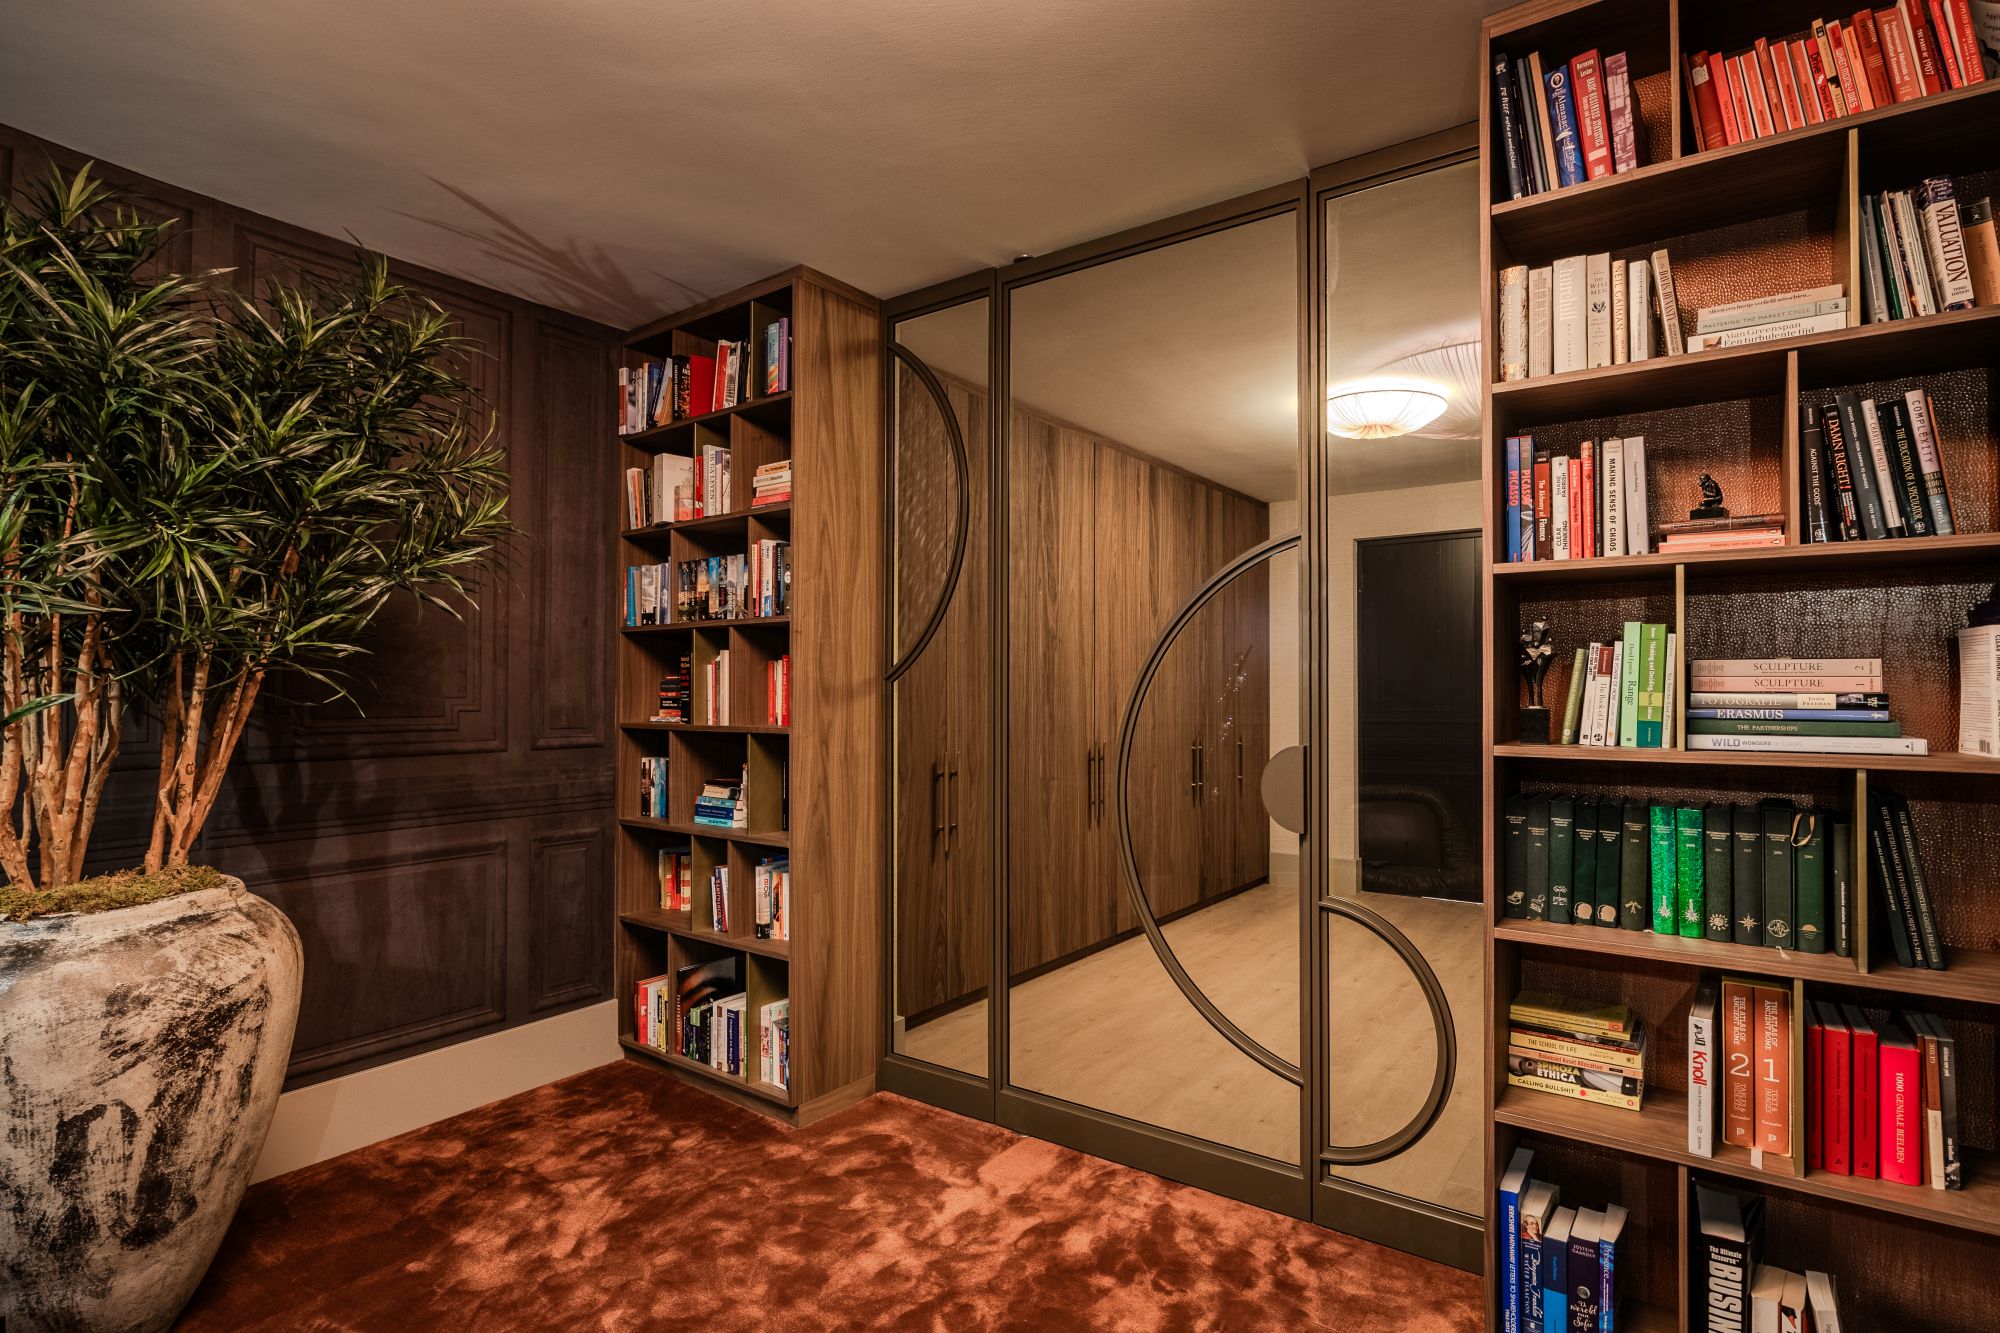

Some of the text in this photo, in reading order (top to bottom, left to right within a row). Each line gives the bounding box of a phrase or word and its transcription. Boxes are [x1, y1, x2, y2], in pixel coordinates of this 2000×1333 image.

[1810, 52, 1822, 74] Drive
[1819, 85, 1830, 103] Daniel
[1836, 48, 1857, 108] WHEN MONEY DIES
[1923, 59, 1934, 75] 1907
[1936, 204, 1968, 283] VALUATION
[1614, 266, 1623, 331] NEIL GAIMAN
[1659, 270, 1676, 321] DAVIS DYNASTY
[1703, 319, 1741, 329] MASTERING
[1789, 308, 1810, 316] CYCLE
[1747, 322, 1801, 335] Greenspan
[1744, 330, 1797, 345] turbulente
[1798, 326, 1814, 337] tijd
[1869, 422, 1881, 447] CHARLIE
[1896, 428, 1906, 439] THE
[1912, 400, 1934, 463] COMPLEXITY
[1828, 419, 1851, 489] DAMN RIGHT!
[1898, 440, 1913, 471] EDUCATION
[1522, 469, 1531, 504] PICASSO
[1906, 472, 1914, 480] OF
[1510, 471, 1518, 506] PICASSO
[1813, 488, 1821, 505] GODS
[1908, 486, 1922, 519] SPECULATOR
[1539, 519, 1548, 541] Finance
[1610, 516, 1616, 524] OF
[1754, 663, 1823, 671] SCULPTURE
[1625, 681, 1636, 705] Range
[1754, 679, 1824, 687] SCULPTURE
[1701, 696, 1782, 706] FOTOGRAFIE
[1717, 710, 1783, 719] ERASMUS
[1712, 738, 1741, 746] WILD
[1897, 872, 1912, 909] STUDENTEN
[1914, 875, 1927, 912] STUDENTEN
[1740, 1033, 1745, 1041] OF
[1772, 1039, 1777, 1047] OF
[1578, 1061, 1603, 1070] Allocation
[1693, 1050, 1707, 1085] Knoll
[1730, 1053, 1749, 1076] 2
[1764, 1058, 1779, 1082] 1
[1518, 1078, 1574, 1094] CALLING BULLSHIT
[1537, 1069, 1576, 1083] ETHICA
[1896, 1072, 1904, 1092] 1000
[1896, 1094, 1904, 1127] GENIALE
[1603, 1245, 1612, 1278] Presence
[1510, 1285, 1515, 1293] TO
[1709, 1260, 1742, 1333] BUSIN
